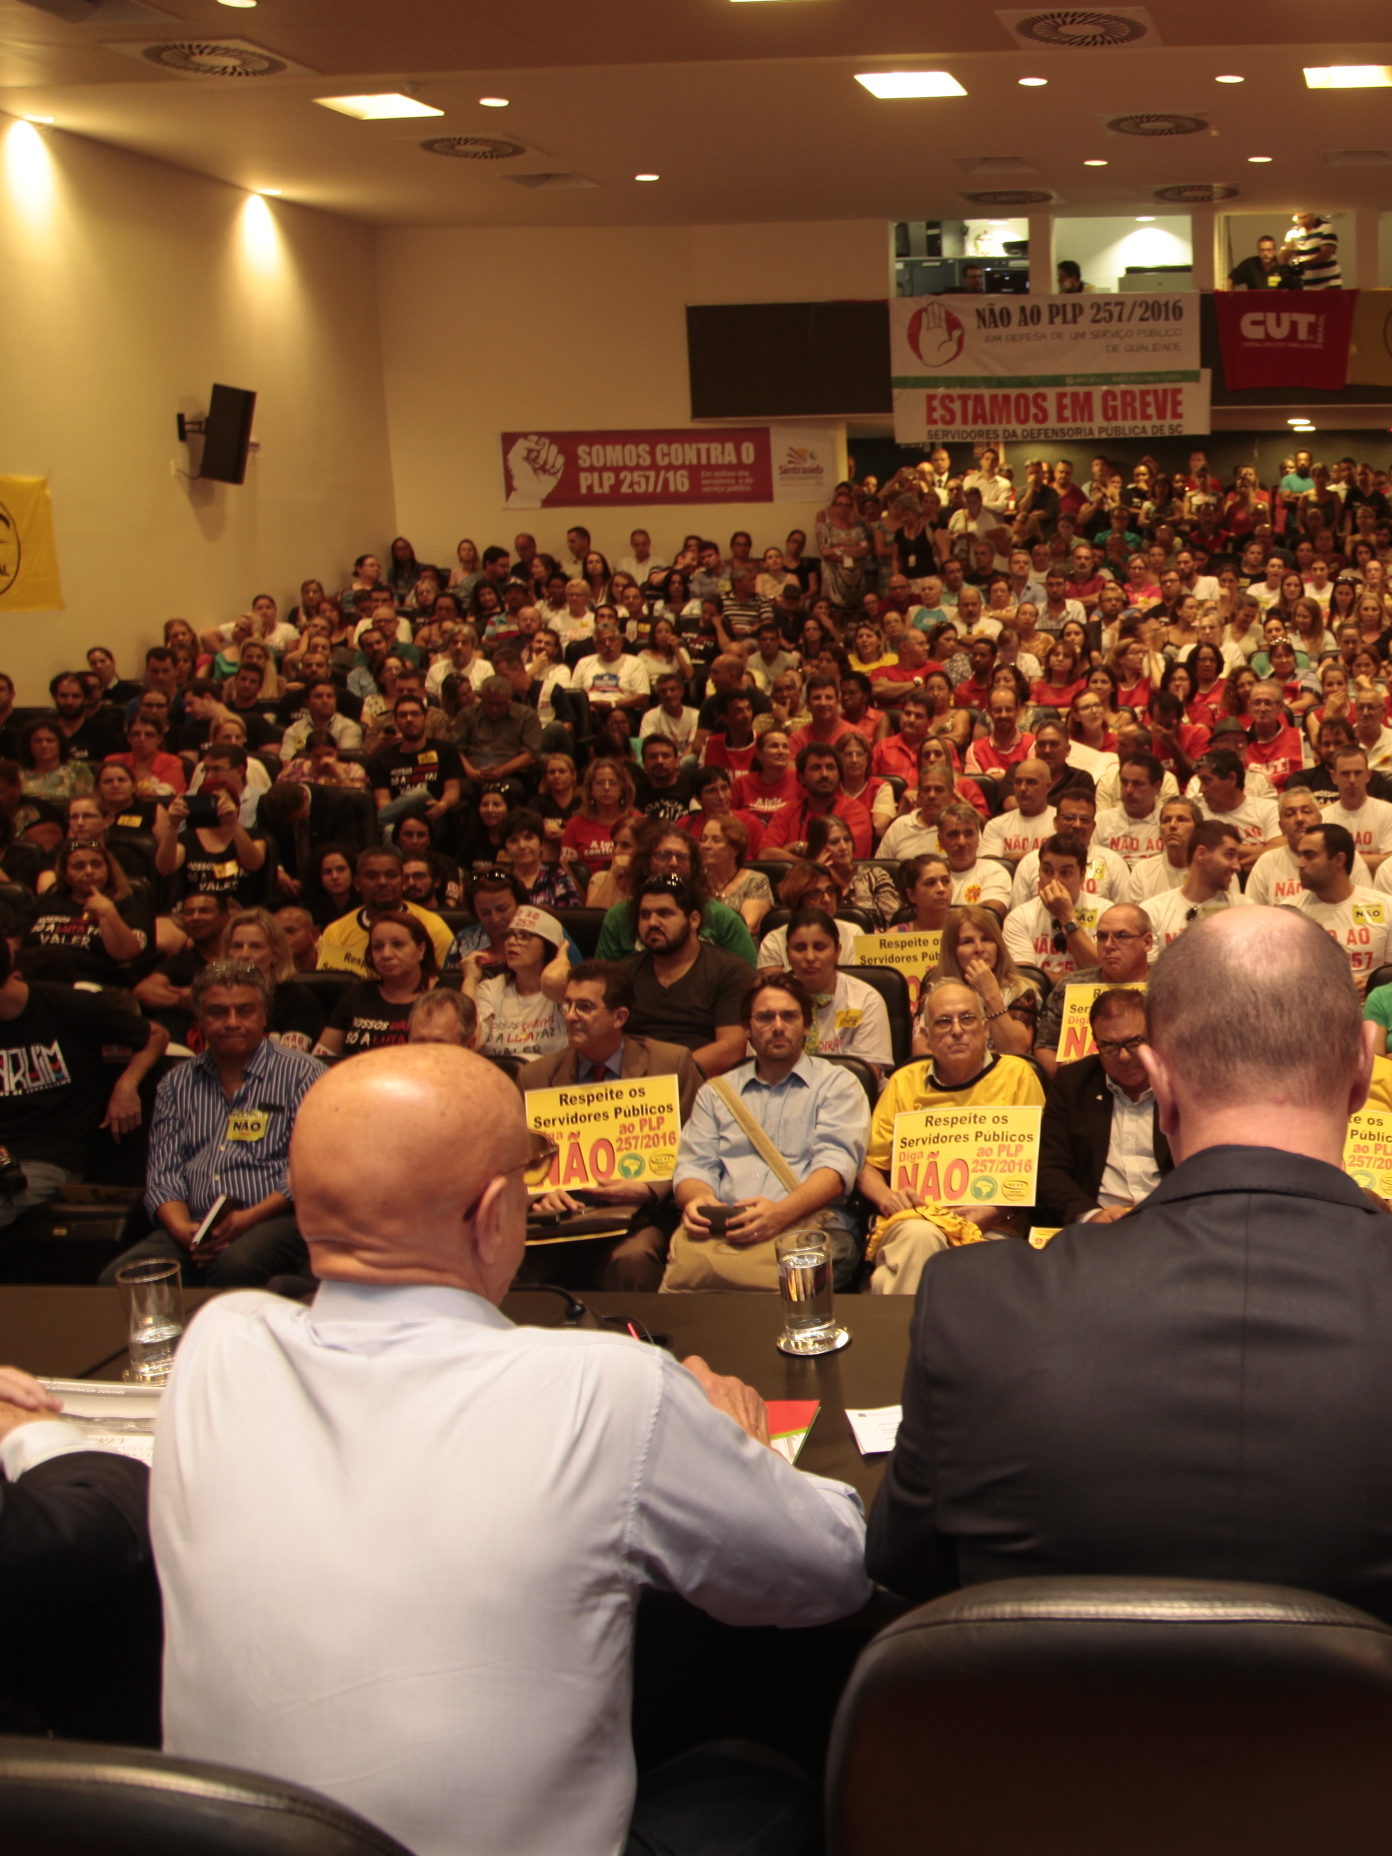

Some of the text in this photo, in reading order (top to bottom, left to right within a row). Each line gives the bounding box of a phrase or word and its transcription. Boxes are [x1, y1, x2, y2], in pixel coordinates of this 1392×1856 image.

[975, 299, 1183, 329] NÃO AO PLP 257/2016
[1240, 312, 1316, 341] CUT
[985, 334, 1002, 343] EM
[1051, 331, 1064, 341] DE
[1106, 344, 1121, 353] DE
[925, 388, 1183, 426] ESTAMOS EM GREVE
[927, 423, 1183, 441] SERVIDORES DA DEFENSORIA PÚBLICA DE SC
[578, 442, 755, 468] SOMOS CONTRA O
[580, 470, 690, 494] PLP 257/16
[1004, 836, 1029, 851] NÃO
[1110, 834, 1166, 851] NÃO AO
[87, 925, 102, 938] FA
[1347, 928, 1371, 946] AO
[40, 932, 92, 950] VALER
[879, 937, 929, 952] Respeite
[860, 952, 918, 965] Servidores
[1350, 951, 1374, 969] 57
[361, 1031, 371, 1045] A
[559, 1087, 646, 1107] Respeite os
[534, 1103, 674, 1129] Servidores Públicos
[925, 1112, 1009, 1128] Respeite os
[1367, 1117, 1384, 1126] os
[233, 1119, 262, 1131] NÃO
[619, 1116, 665, 1135] ao PLP
[616, 1131, 677, 1152] 257/2016
[900, 1131, 1034, 1149] Servidores Públicos
[899, 1150, 924, 1164] Diga
[977, 1143, 1024, 1158] ao PLP
[1353, 1144, 1370, 1154] ao
[971, 1159, 1033, 1174] 257/2016
[897, 1151, 970, 1201] NÃO
